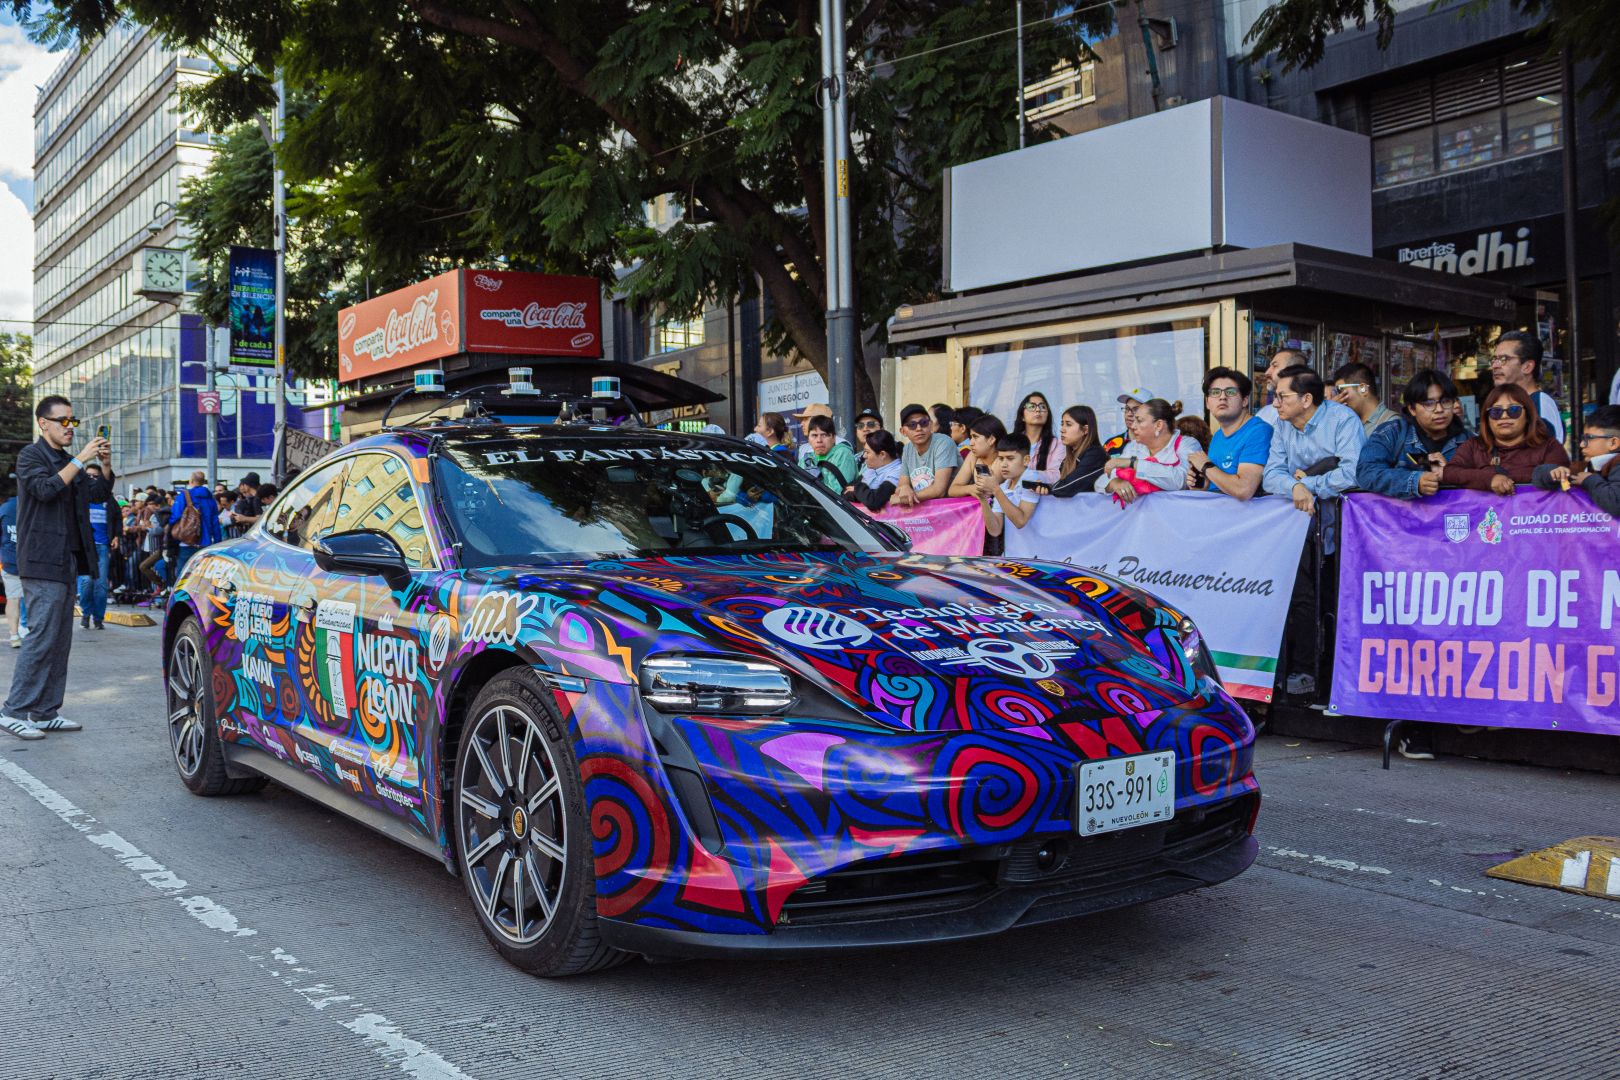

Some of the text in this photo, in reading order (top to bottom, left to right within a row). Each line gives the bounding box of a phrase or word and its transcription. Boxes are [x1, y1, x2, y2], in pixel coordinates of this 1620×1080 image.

[1398, 241, 1456, 262] librerías
[481, 309, 521, 319] comparte
[355, 332, 384, 353] comparte
[768, 383, 793, 394] JUNTOS
[777, 391, 810, 404] NEGOCIO
[481, 446, 778, 468] EL FANTÁSTICO
[1510, 512, 1612, 526] CIUDAD DE MÉXICO
[1509, 527, 1533, 536] CAPITAL
[1533, 527, 1543, 535] DE
[1554, 525, 1612, 534] TRANSFORMACIÓN
[1117, 554, 1276, 597] Panamericana
[1526, 570, 1580, 629] DE
[850, 601, 1058, 621] Tecnológico
[892, 618, 1113, 640] de Monterrey
[1358, 637, 1565, 704] CORAZÓN
[1085, 774, 1153, 813] 33S-991
